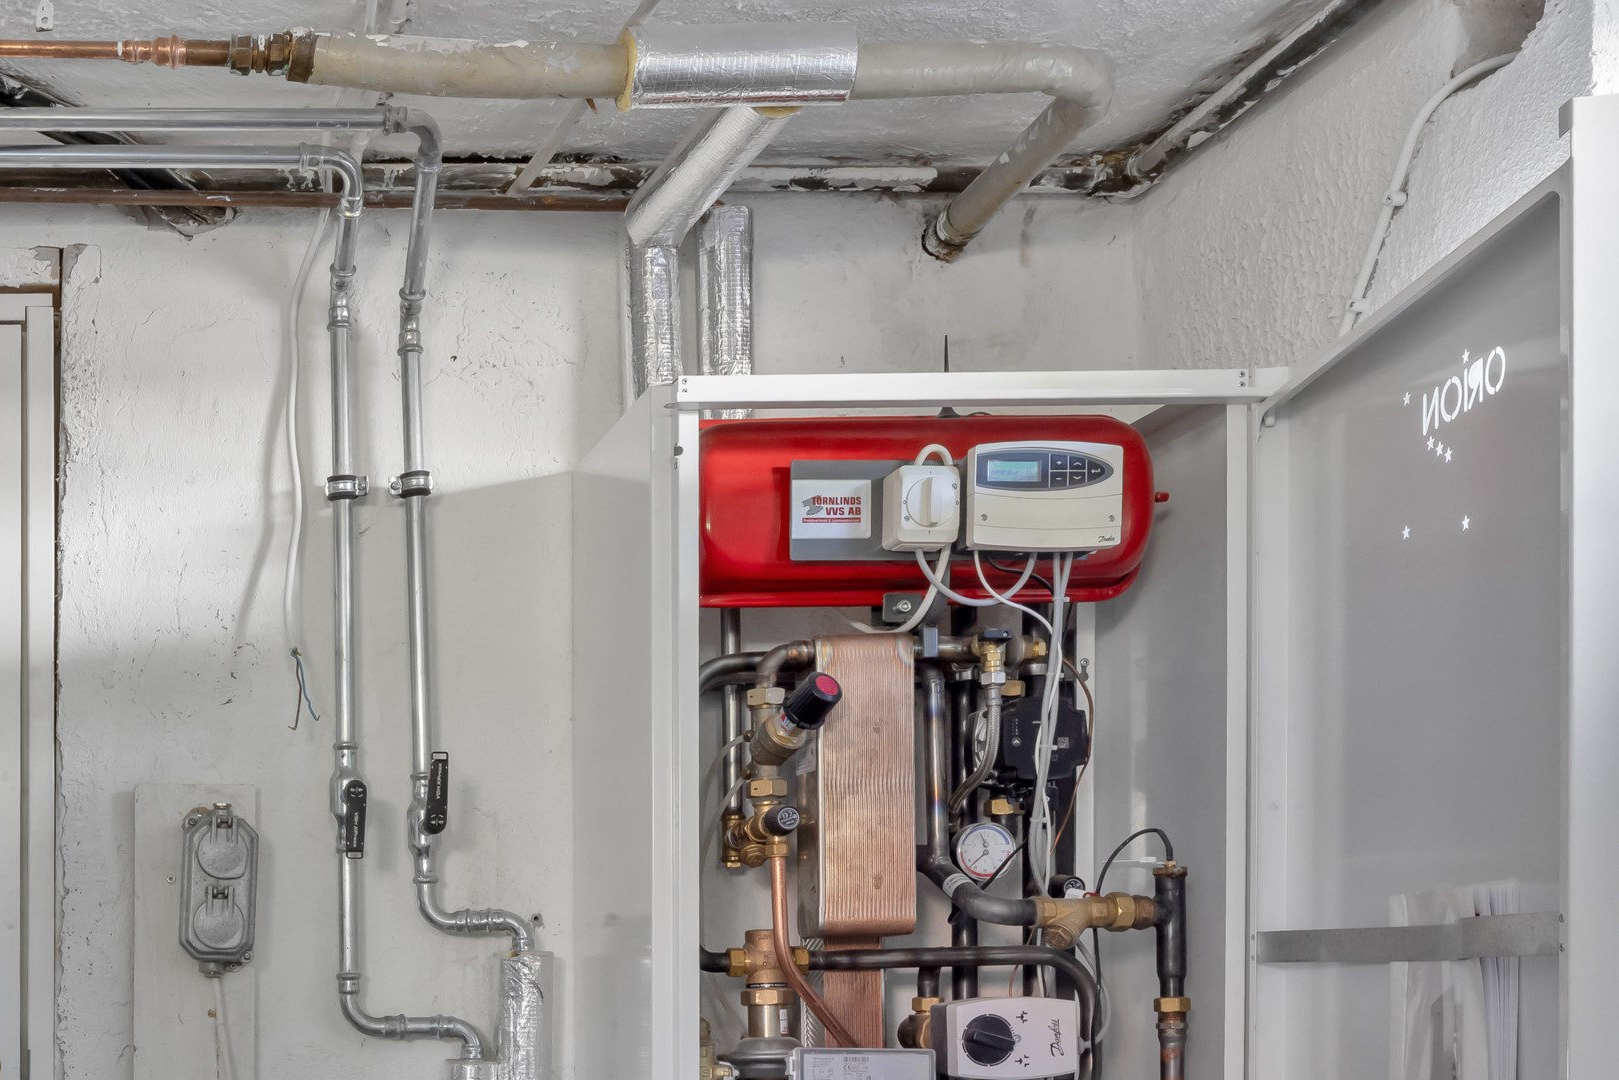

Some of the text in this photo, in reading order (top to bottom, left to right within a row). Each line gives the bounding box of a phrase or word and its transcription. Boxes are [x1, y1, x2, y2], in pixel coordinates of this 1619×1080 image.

[812, 495, 861, 506] TÖRNLINDS
[825, 507, 861, 516] VVS AB
[1047, 1018, 1064, 1057] Danfoss
